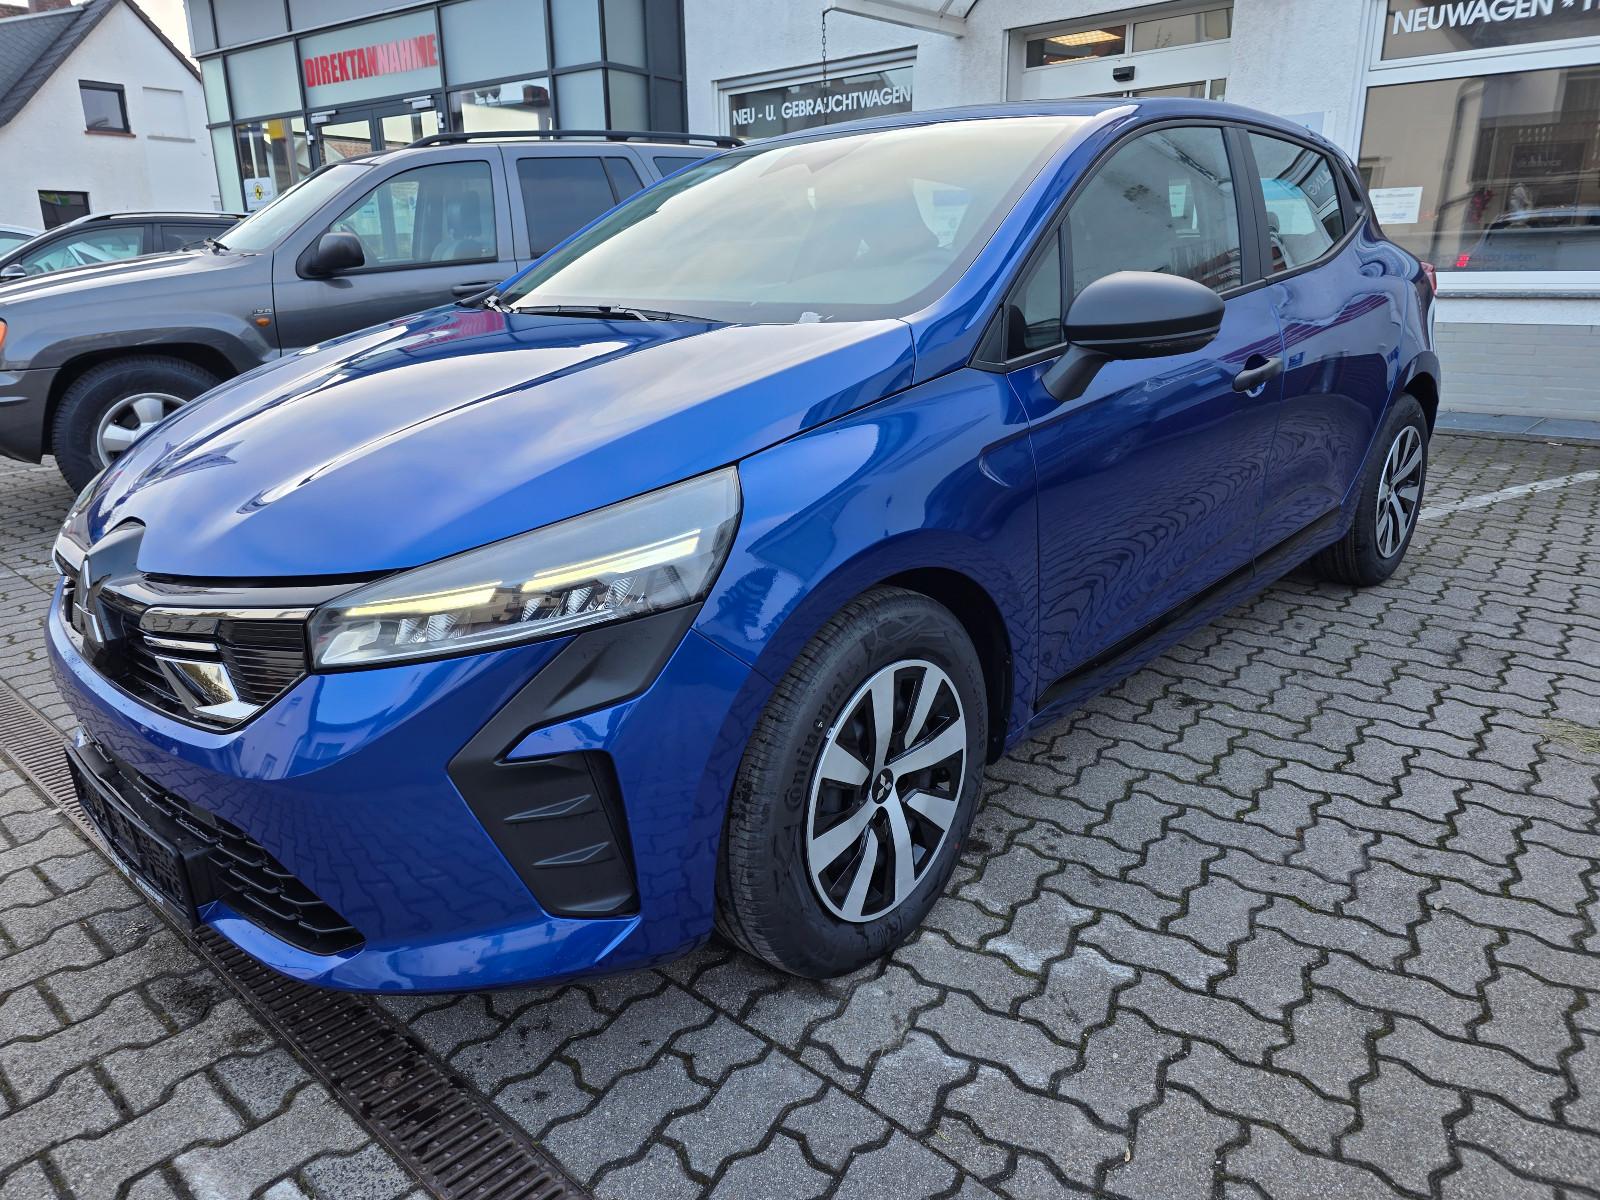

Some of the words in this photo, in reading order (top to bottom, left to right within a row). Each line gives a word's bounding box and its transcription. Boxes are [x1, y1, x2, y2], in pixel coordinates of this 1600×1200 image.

[1393, 0, 1553, 35] NEUWAGEN
[303, 33, 438, 88] DIREKTANNAHME
[732, 108, 755, 126] NEU
[765, 104, 776, 121] U.
[781, 85, 912, 119] GEBRAUCHTWAGEN
